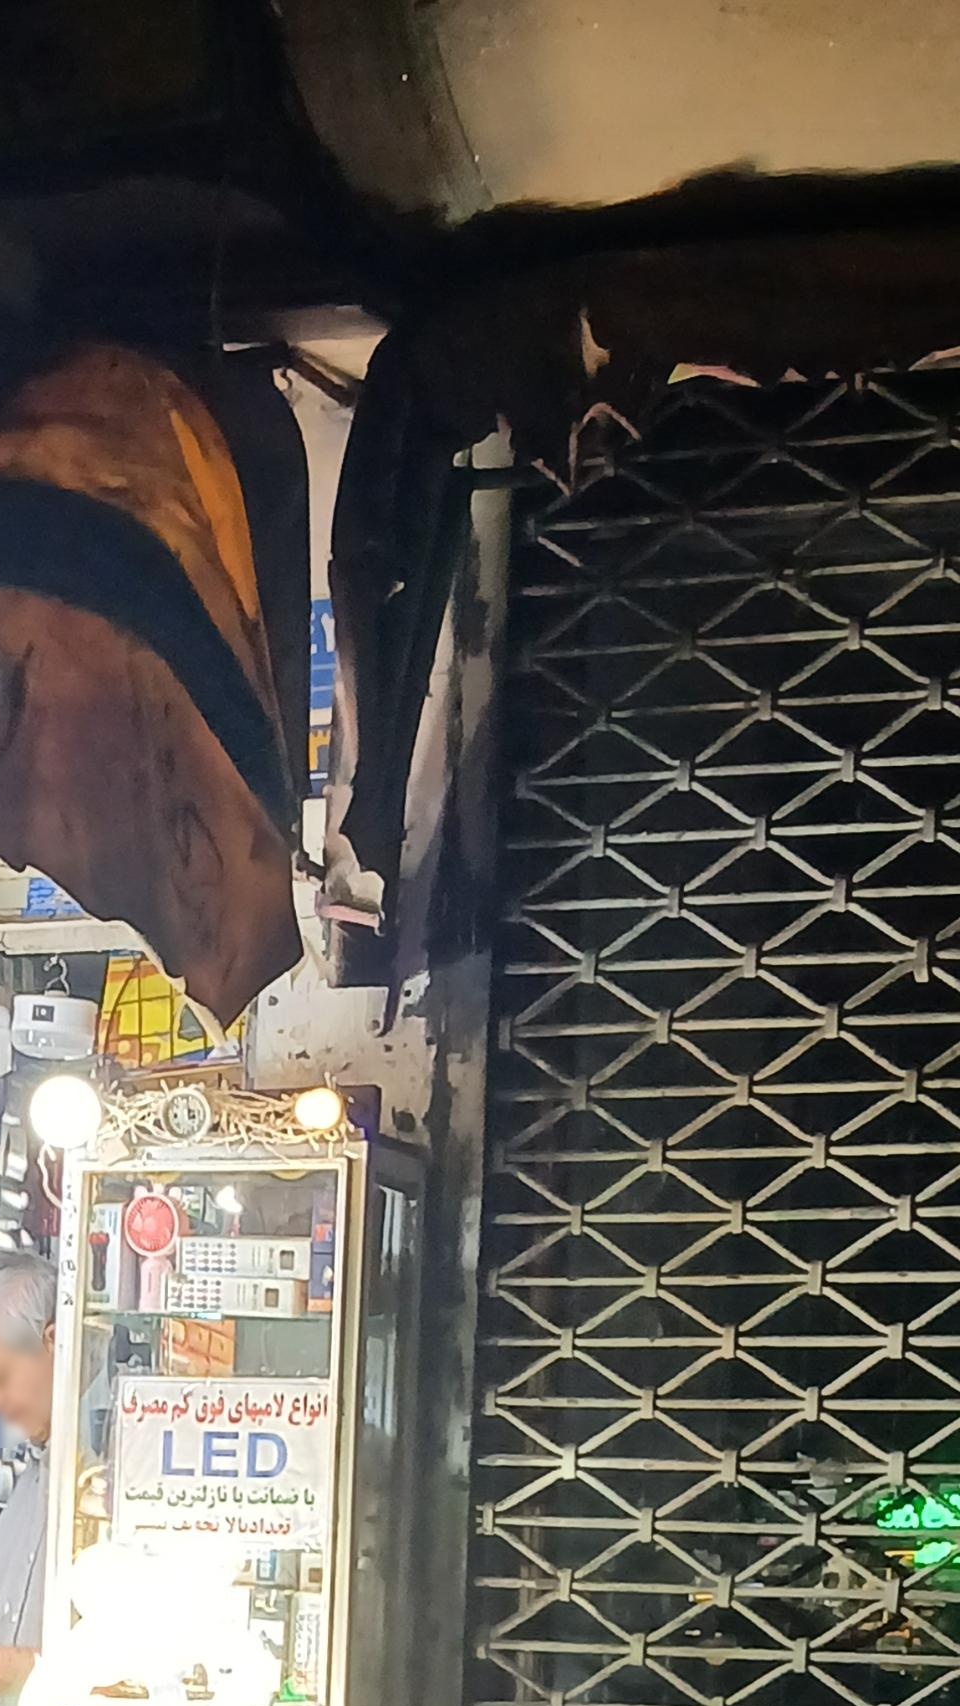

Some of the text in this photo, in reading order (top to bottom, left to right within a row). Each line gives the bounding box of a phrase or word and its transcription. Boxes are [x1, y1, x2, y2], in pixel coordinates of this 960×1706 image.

[195, 1389, 225, 1424] فوق
[228, 1391, 285, 1426] لامپهای
[288, 1391, 328, 1426] انواع
[160, 1430, 288, 1479] LED
[303, 1488, 316, 1511] با
